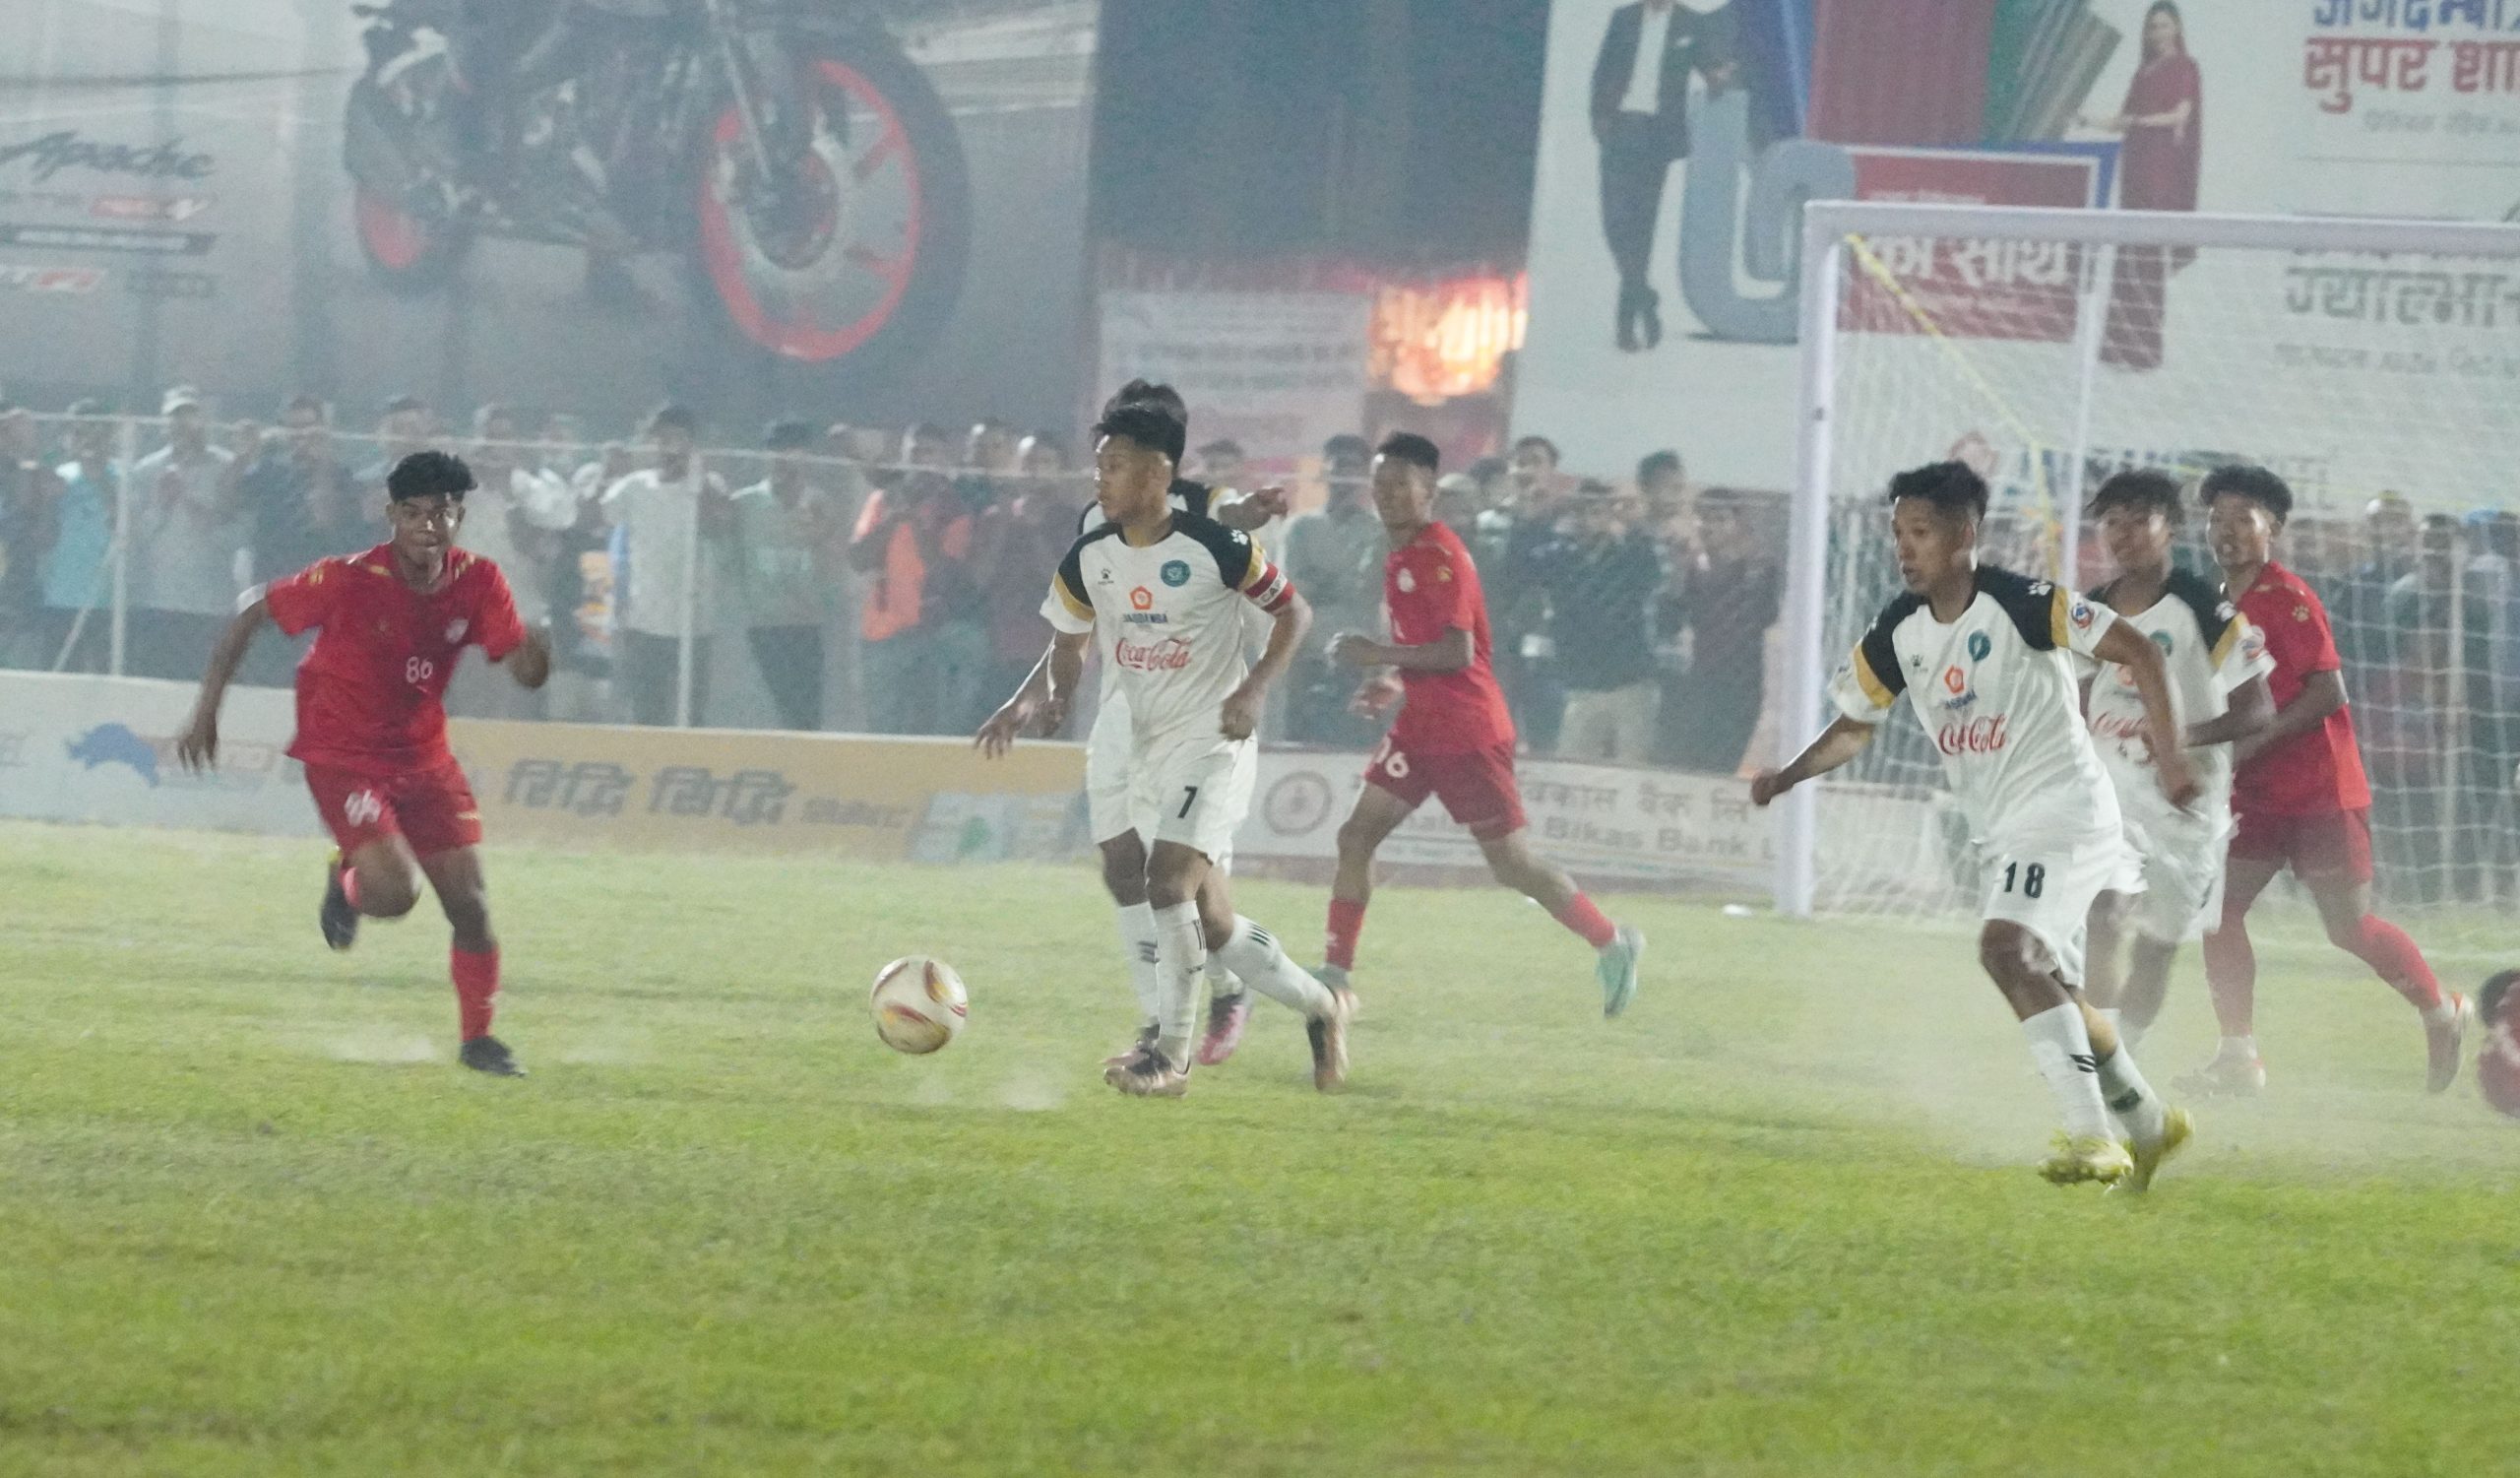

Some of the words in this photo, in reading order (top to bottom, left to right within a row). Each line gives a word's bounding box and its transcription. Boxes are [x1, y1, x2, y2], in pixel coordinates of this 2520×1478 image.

[2304, 36, 2438, 114] सुपर
[1177, 786, 1199, 818] 7
[2003, 861, 2046, 899] 18
